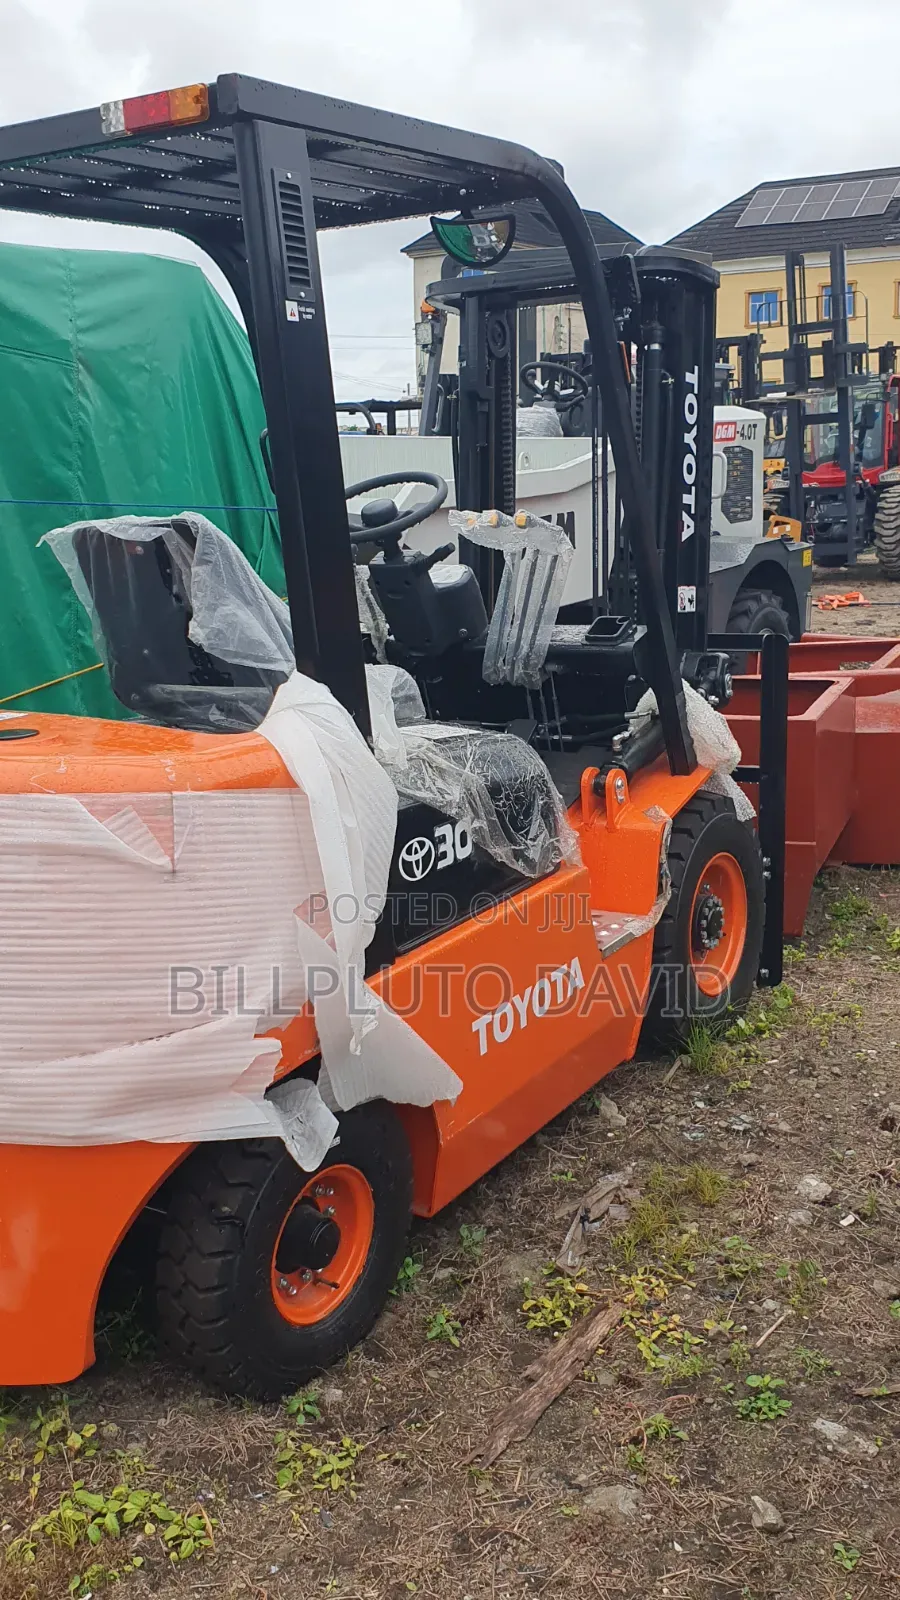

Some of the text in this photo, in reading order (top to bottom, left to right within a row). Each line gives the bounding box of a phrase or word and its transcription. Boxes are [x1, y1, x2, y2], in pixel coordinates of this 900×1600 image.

[682, 365, 698, 542] TOYOTA
[434, 819, 472, 869] 30
[472, 957, 585, 1056] TOYOTA
